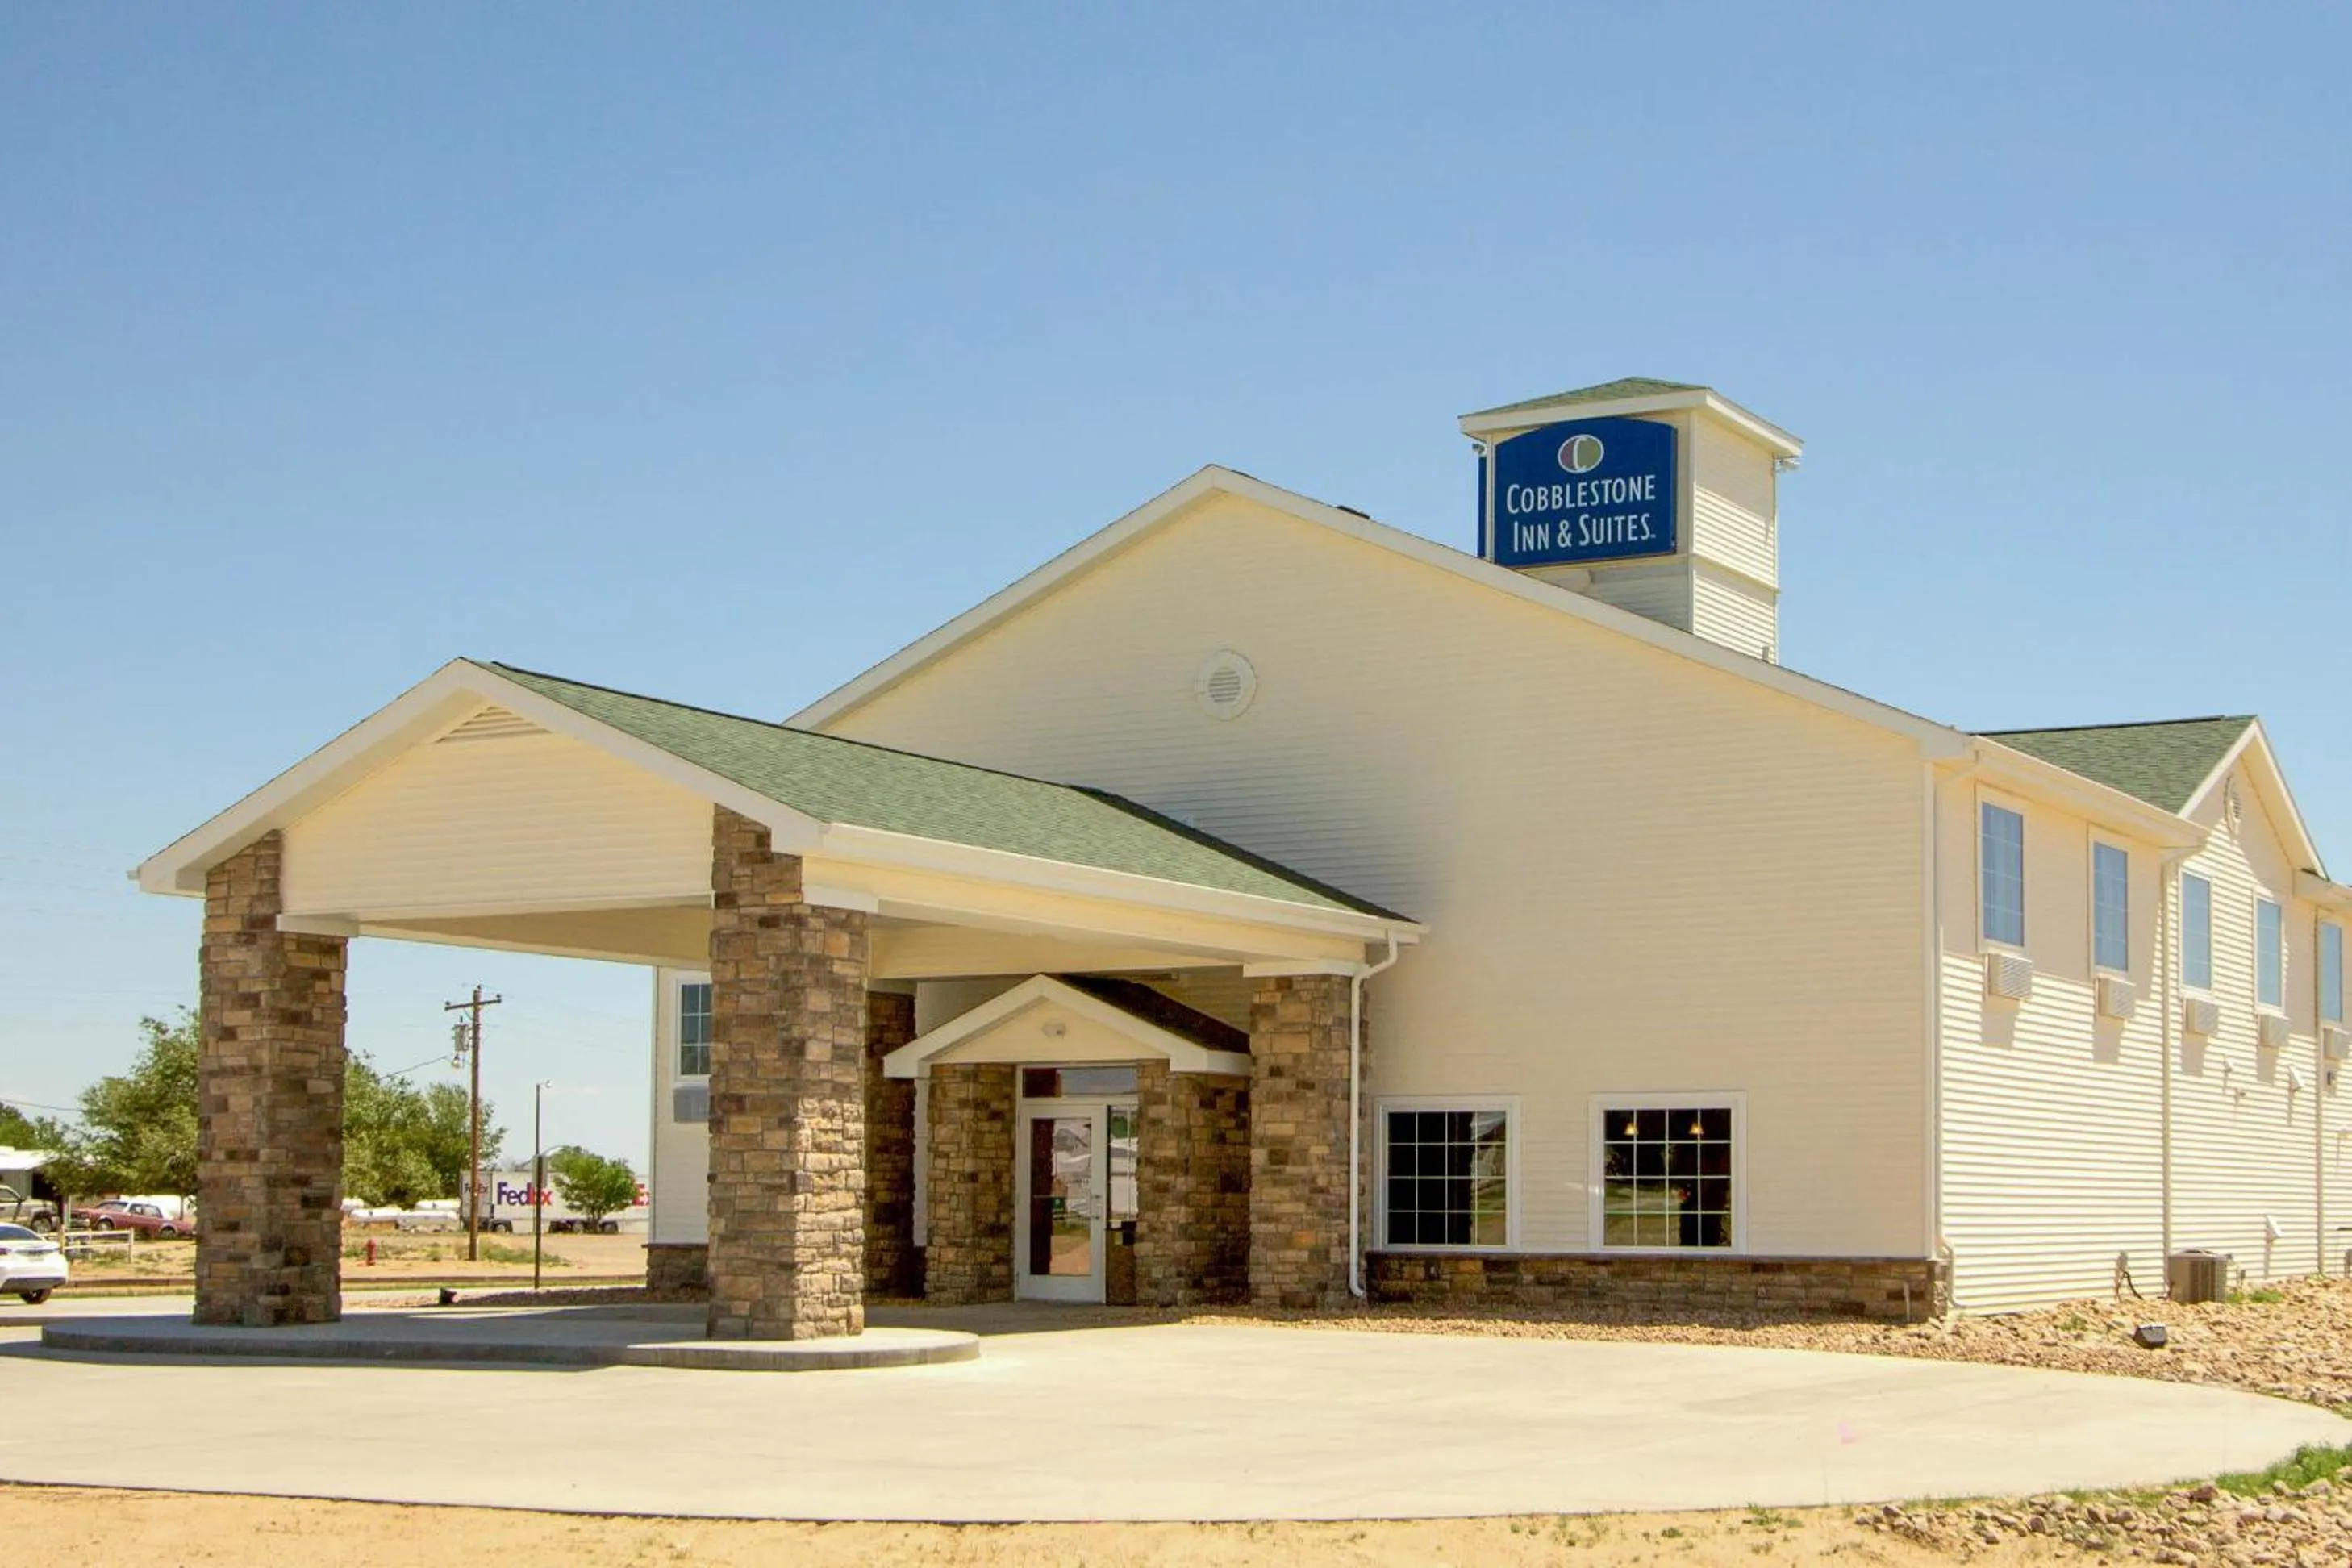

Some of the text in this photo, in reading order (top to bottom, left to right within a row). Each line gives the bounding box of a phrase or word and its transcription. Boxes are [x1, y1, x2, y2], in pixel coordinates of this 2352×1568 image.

[1506, 474, 1657, 514] COBBLESTONE
[1513, 513, 1651, 553] INN & SUITES
